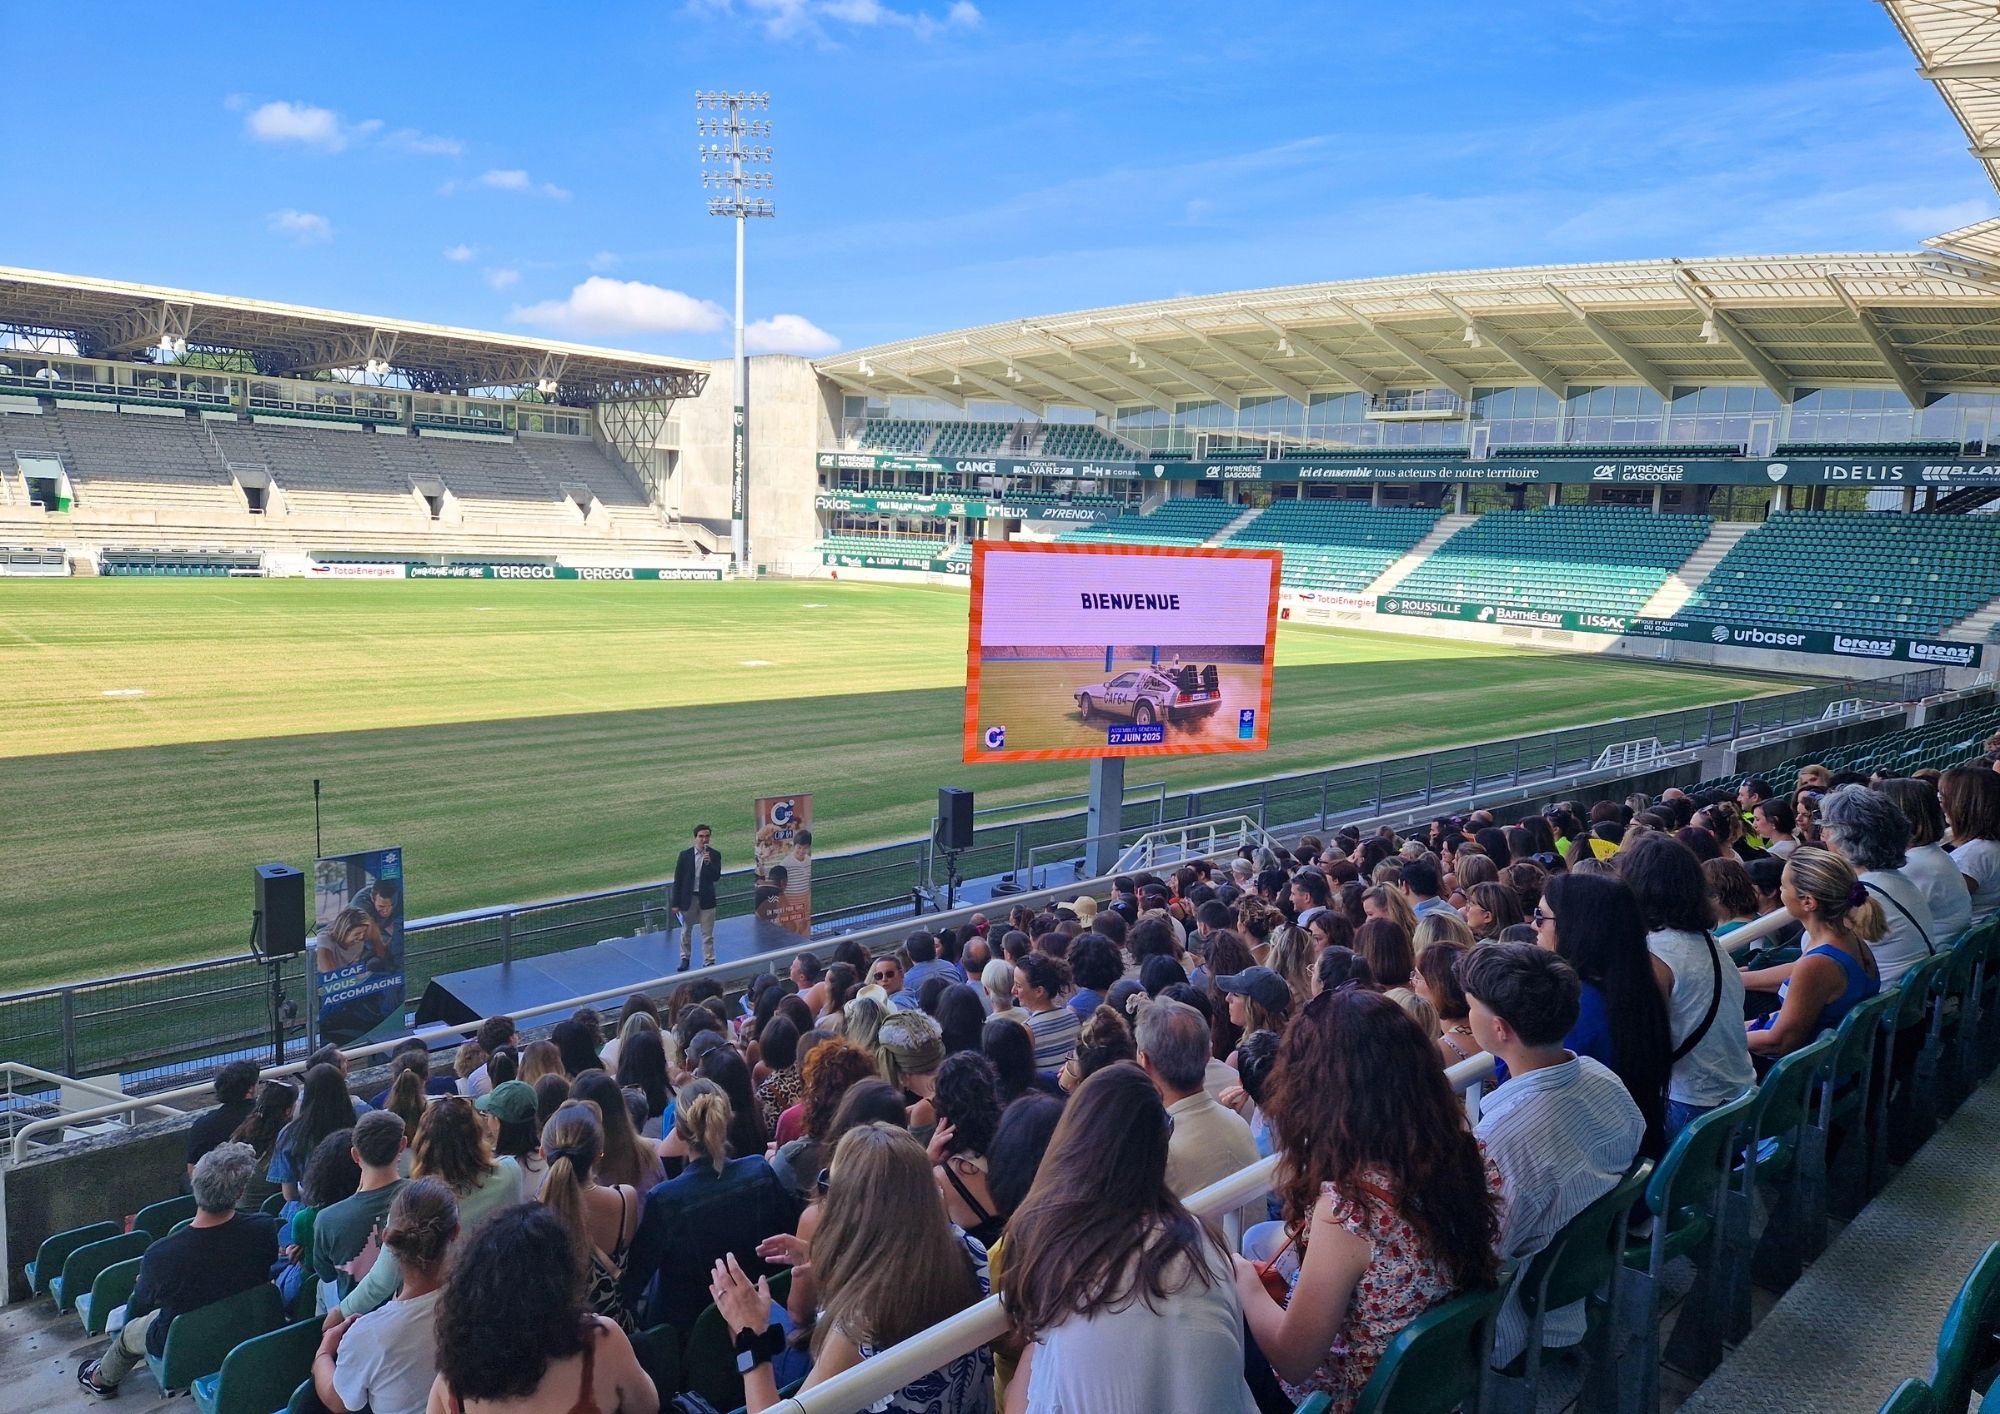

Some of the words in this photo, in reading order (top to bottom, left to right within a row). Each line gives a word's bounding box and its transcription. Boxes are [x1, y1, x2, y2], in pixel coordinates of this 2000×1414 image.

[1018, 466, 1067, 475] ALVAREZ
[1224, 464, 1262, 472] PYRÉNÉES
[1299, 466, 1312, 477] ici
[1313, 467, 1323, 477] et
[1323, 467, 1372, 477] ensemble
[1375, 468, 1395, 477] tous
[1398, 468, 1436, 477] acteurs
[1439, 467, 1452, 477] de
[1455, 468, 1484, 477] notre
[1487, 467, 1539, 478] territoire
[1623, 463, 1684, 473] PYRÉNÉES
[1823, 466, 1904, 480] IDELIS
[1622, 473, 1683, 481] GASCOGNE
[876, 557, 899, 565] LEROY
[333, 566, 395, 577] TotalEnergies
[658, 568, 718, 580] castorama
[1081, 592, 1180, 610] BIENVENUE
[1317, 595, 1375, 608] TotalEnergies
[1402, 600, 1461, 614] ROUSSILLE
[1734, 628, 1805, 646] urbaser
[1833, 635, 1896, 655] Lorenzi
[1908, 642, 1975, 662] Lorenzi
[1110, 734, 1120, 743] 27
[1122, 733, 1141, 742] JUIN
[1142, 732, 1161, 742] 2025
[323, 972, 338, 983] LA
[341, 964, 363, 978] CAF
[324, 978, 357, 993] VOUS
[324, 975, 402, 1006] ACCOMPAGNE
